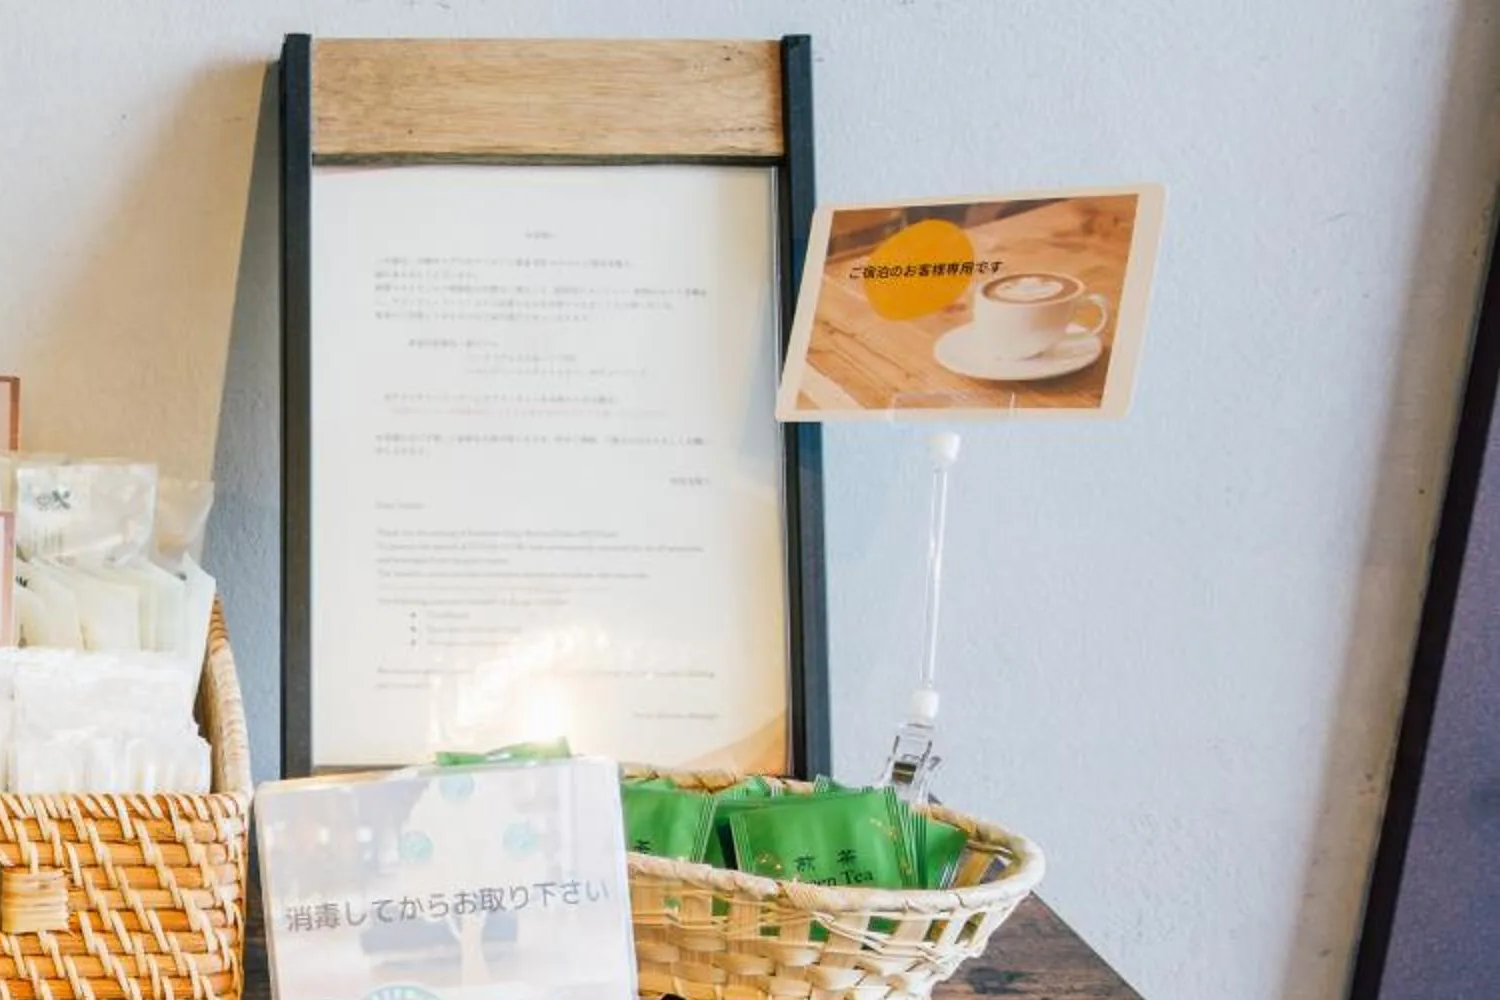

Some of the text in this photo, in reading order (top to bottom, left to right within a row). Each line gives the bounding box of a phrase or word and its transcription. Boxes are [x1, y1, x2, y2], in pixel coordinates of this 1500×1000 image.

[850, 260, 1003, 280] ご宿泊のお客様専用です
[840, 869, 874, 884] Tea
[286, 878, 610, 933] 消毒してからお取り下さい
